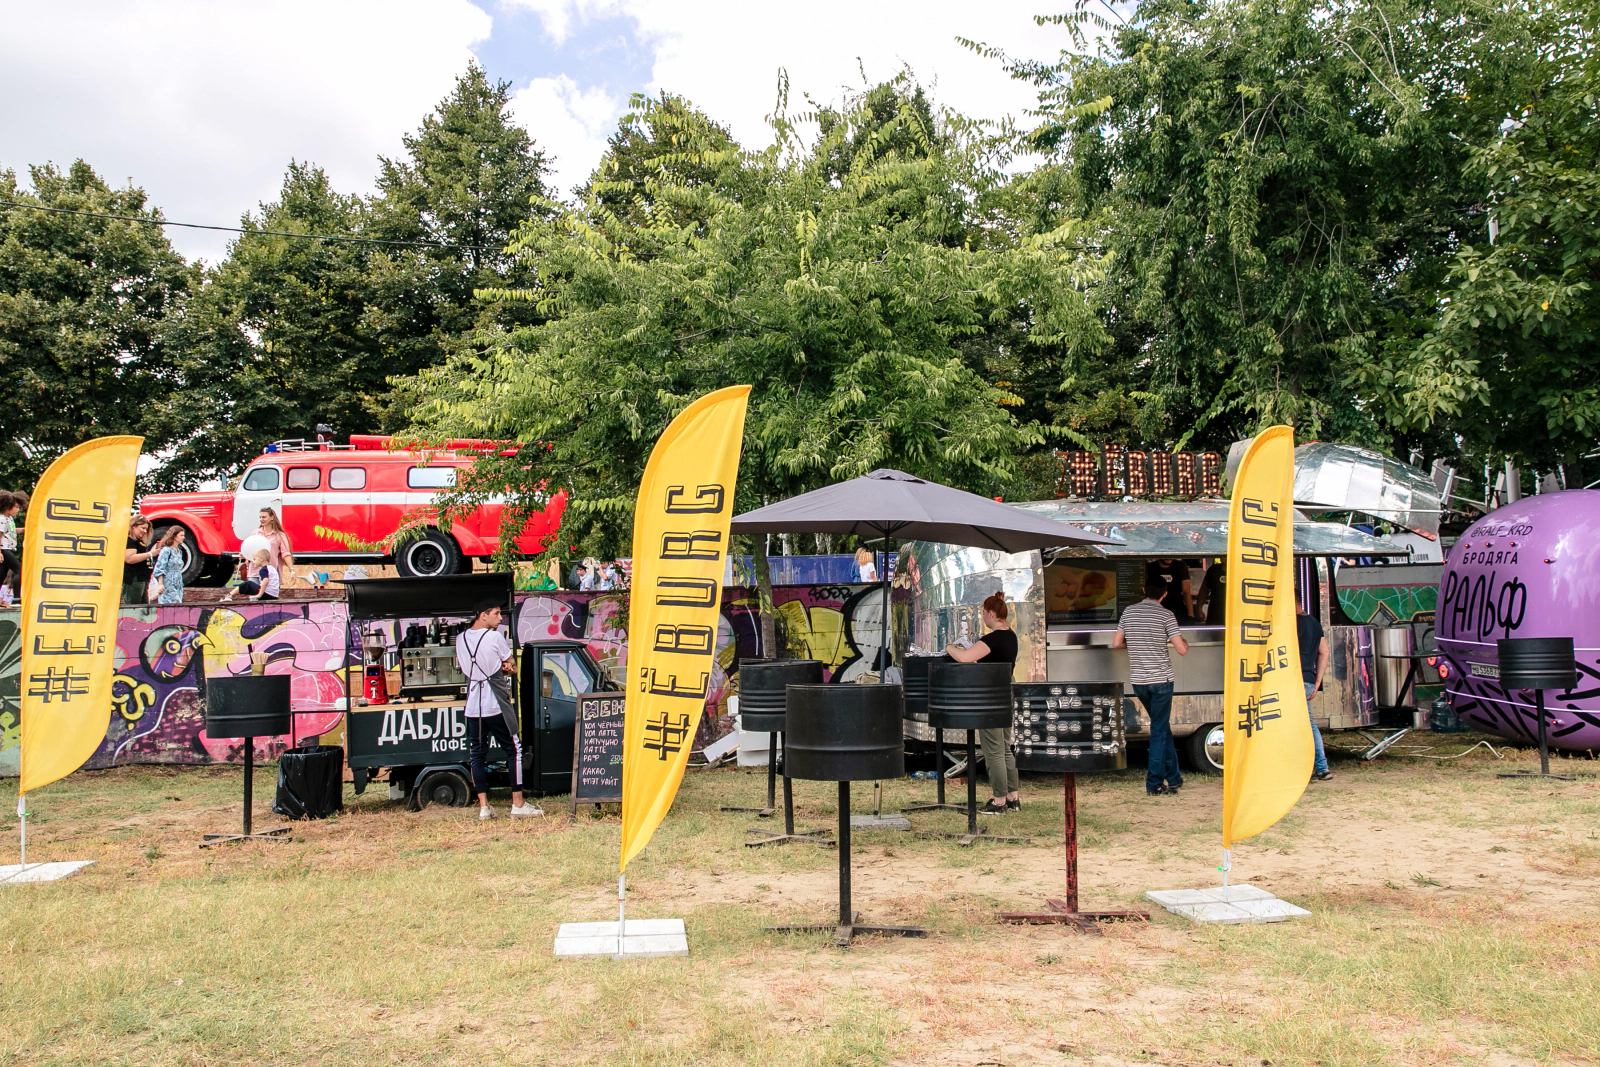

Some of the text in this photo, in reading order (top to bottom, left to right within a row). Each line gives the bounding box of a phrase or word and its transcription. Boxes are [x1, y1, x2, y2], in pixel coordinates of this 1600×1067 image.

[1470, 524, 1534, 538] @RALF_KRD
[1462, 551, 1518, 566] БРОДЯГА
[1441, 570, 1527, 643] РАЛЬФ
[582, 699, 626, 720] МЕН
[583, 746, 607, 754] ЛАТТЕ
[583, 755, 600, 763] РАФ
[582, 767, 606, 776] КАКАО
